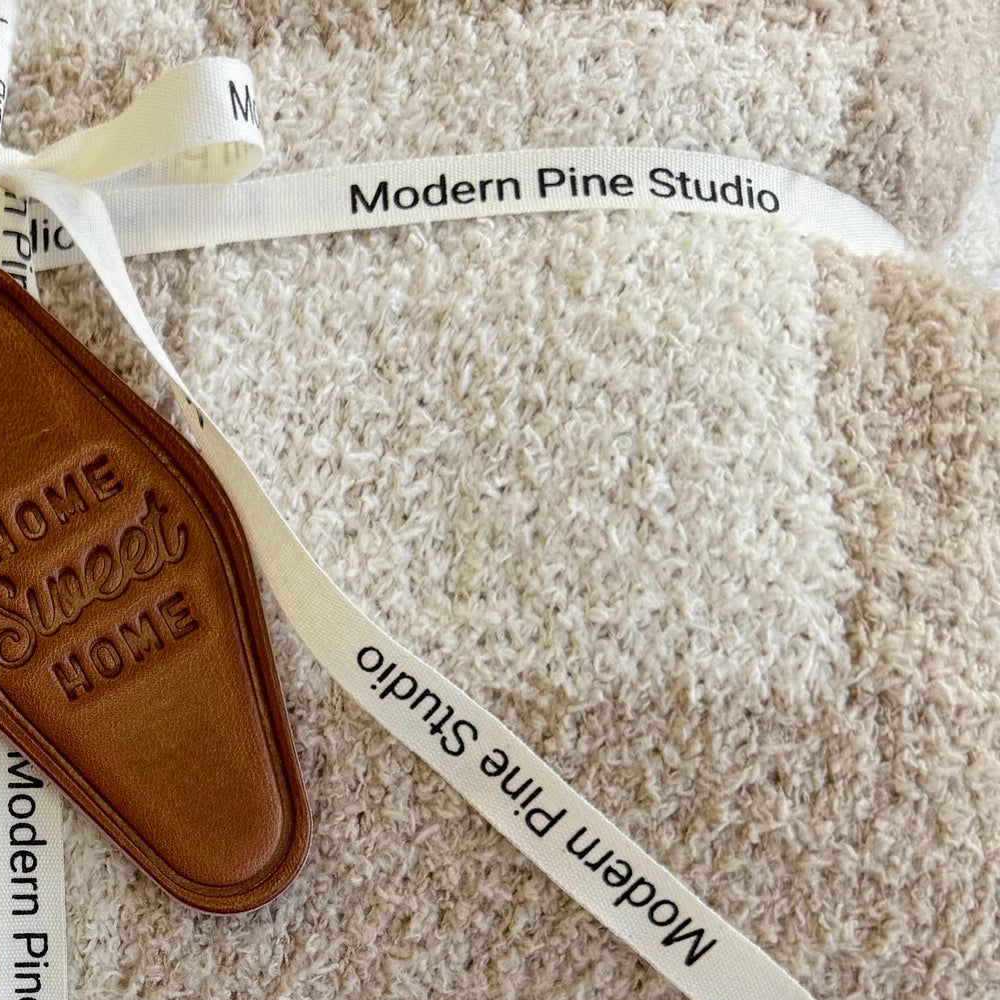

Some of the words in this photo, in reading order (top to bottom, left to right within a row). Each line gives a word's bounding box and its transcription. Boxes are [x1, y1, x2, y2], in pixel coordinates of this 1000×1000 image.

[350, 174, 521, 214] Modern
[537, 166, 635, 198] Pine
[649, 167, 781, 214] Studio
[51, 592, 198, 702] HOME
[356, 645, 478, 757] Studio
[7, 751, 48, 916] Modern
[480, 747, 567, 838] Pine
[565, 825, 718, 967] Modern
